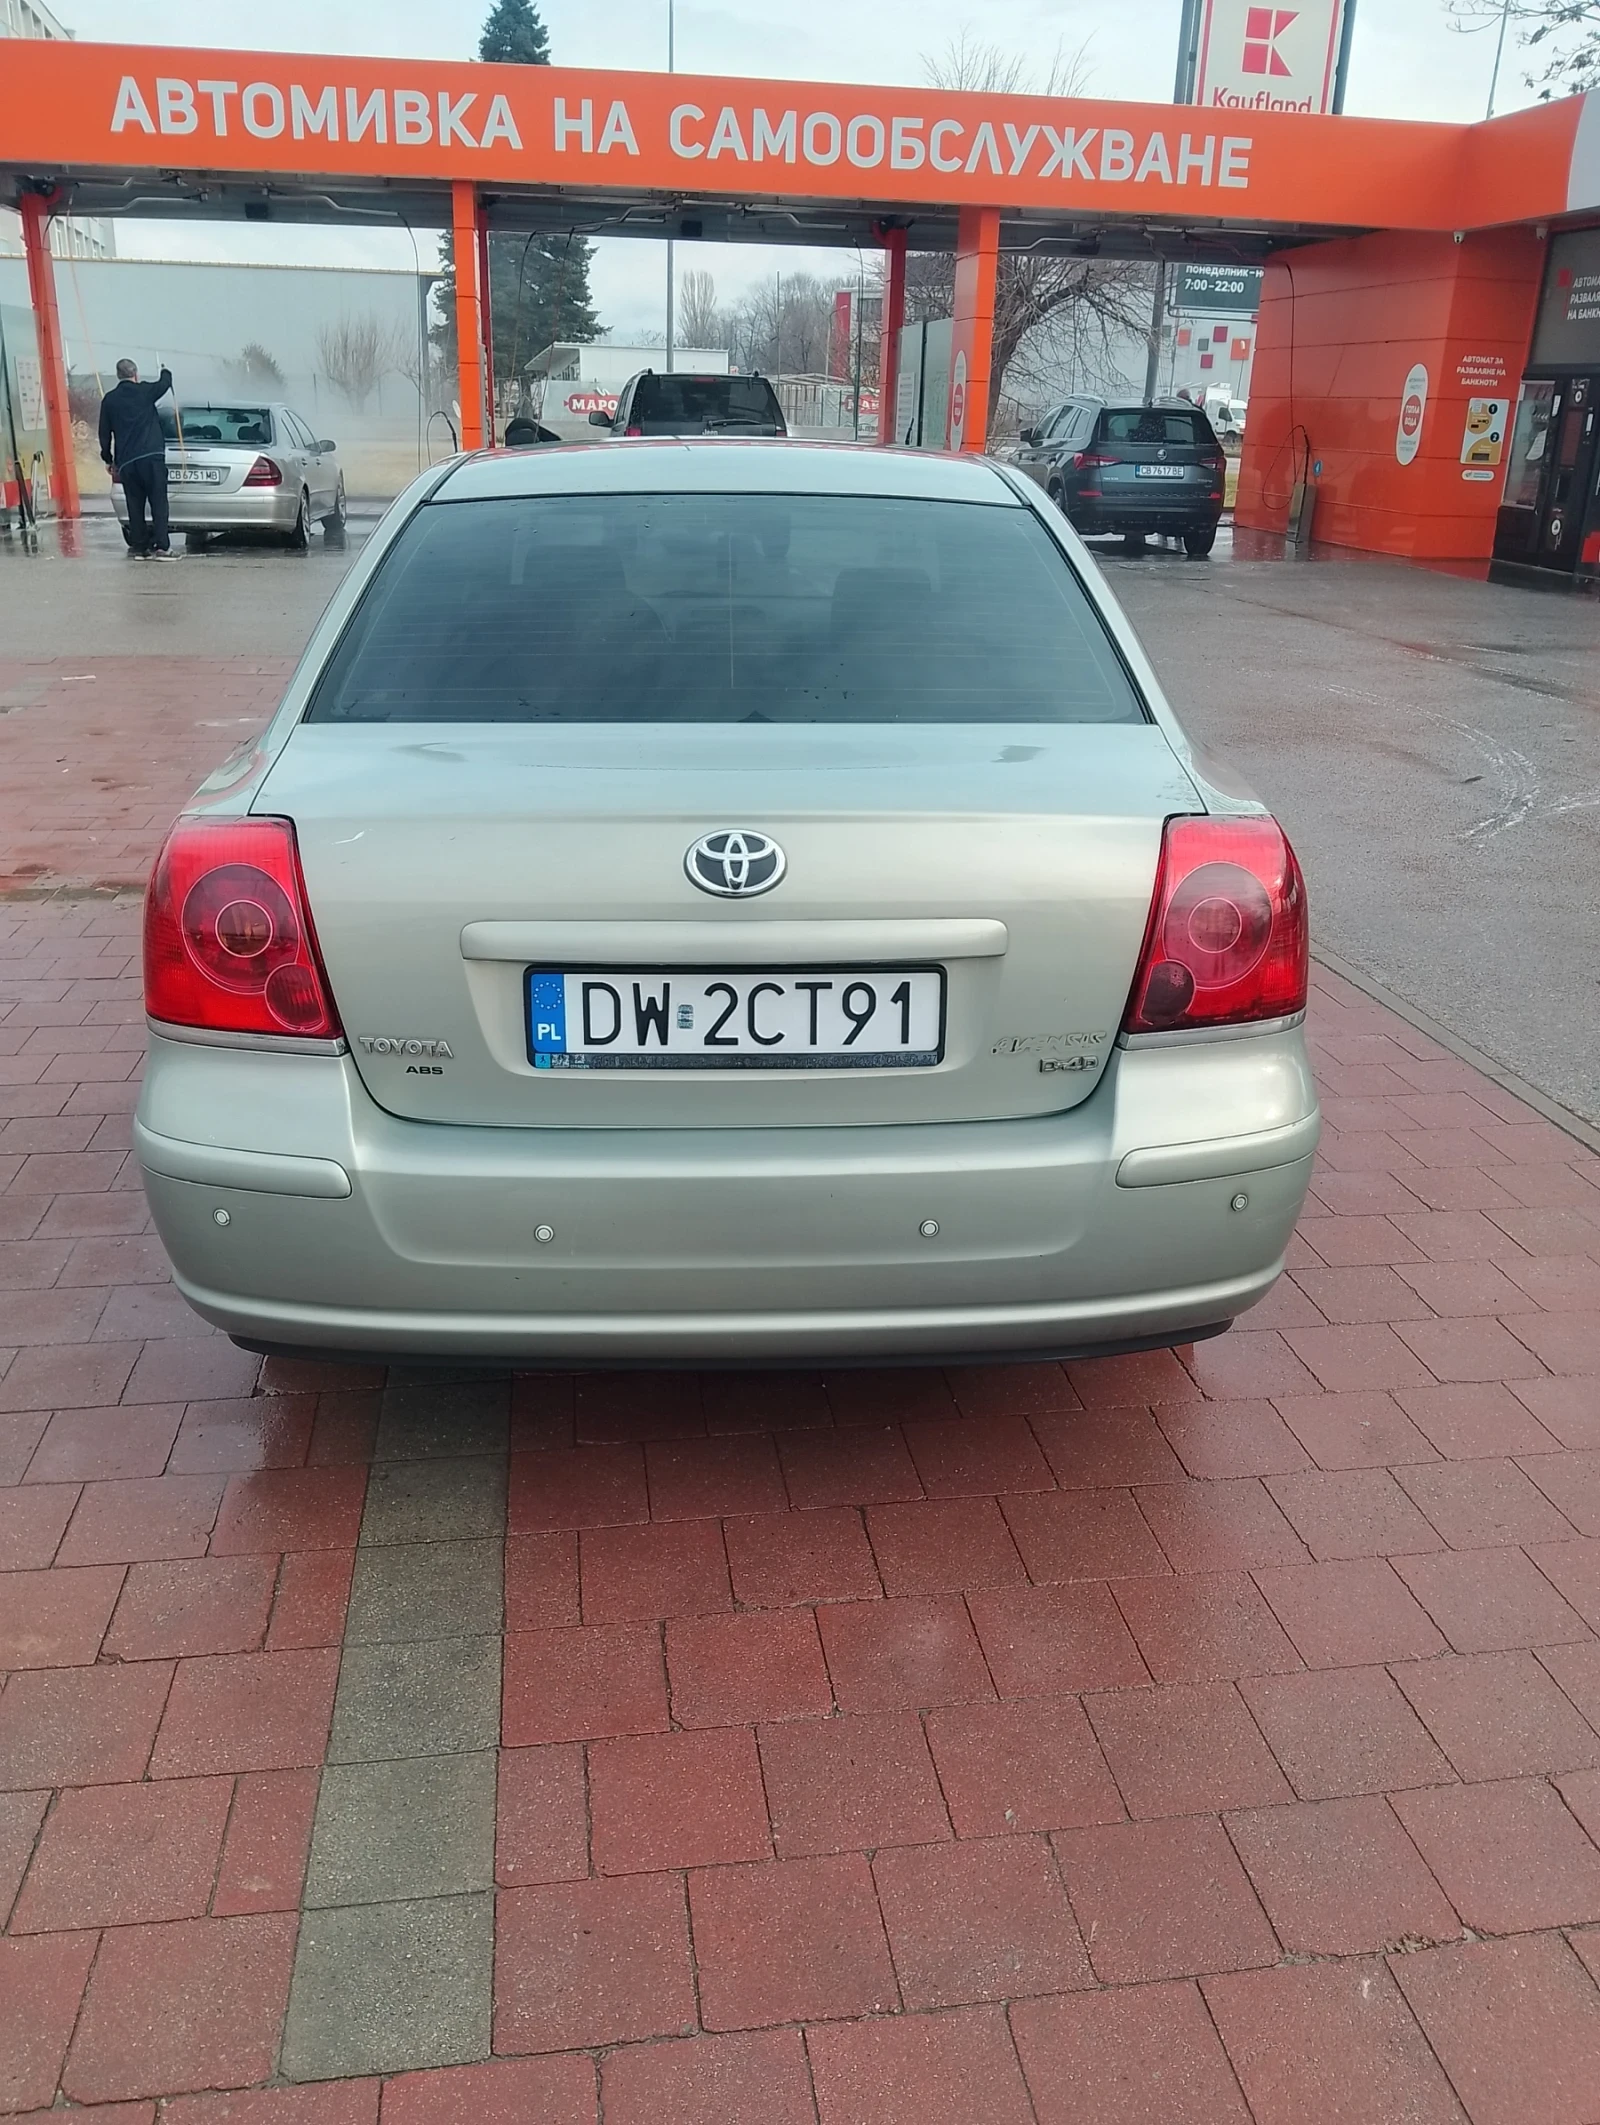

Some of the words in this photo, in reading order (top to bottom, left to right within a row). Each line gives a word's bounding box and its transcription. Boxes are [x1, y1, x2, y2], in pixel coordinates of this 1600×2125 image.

[1212, 87, 1313, 113] Kaufland
[110, 75, 524, 150] АВТОМИВКА
[554, 97, 641, 156] НА
[669, 103, 1253, 189] САМООБСЛУЖВАНЕ
[1566, 309, 1577, 320] НА
[1462, 355, 1494, 364] АВТОМАТ
[582, 981, 671, 1046] DW
[703, 981, 911, 1046] 2CT91
[537, 1023, 562, 1041] PL
[359, 1036, 454, 1059] TOYOTA
[405, 1065, 444, 1075] ABS
